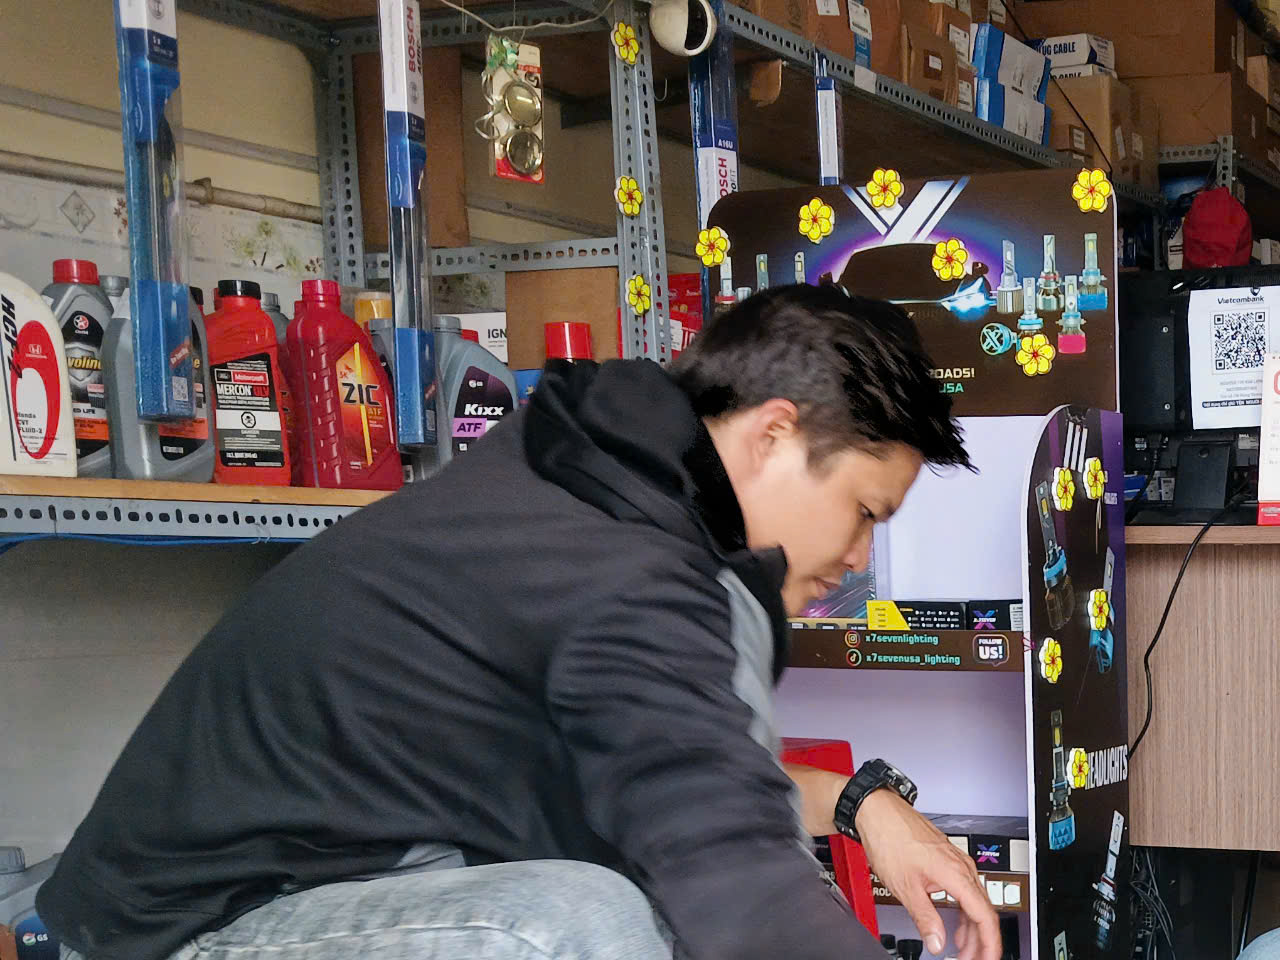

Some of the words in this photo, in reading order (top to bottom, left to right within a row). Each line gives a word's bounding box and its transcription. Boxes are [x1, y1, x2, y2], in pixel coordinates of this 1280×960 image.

[406, 5, 417, 73] BOSCH
[1053, 41, 1076, 54] CABLE
[1217, 295, 1265, 304] Vietcombank
[216, 383, 252, 396] MERCON
[341, 382, 381, 406] ZIC
[464, 403, 504, 416] Kixx
[457, 422, 482, 433] ATF
[865, 632, 939, 645] x7sevenlighting
[978, 638, 1003, 646] FOLLOW
[978, 645, 1004, 660] US!
[866, 653, 961, 666] x7sevenusa_lighting
